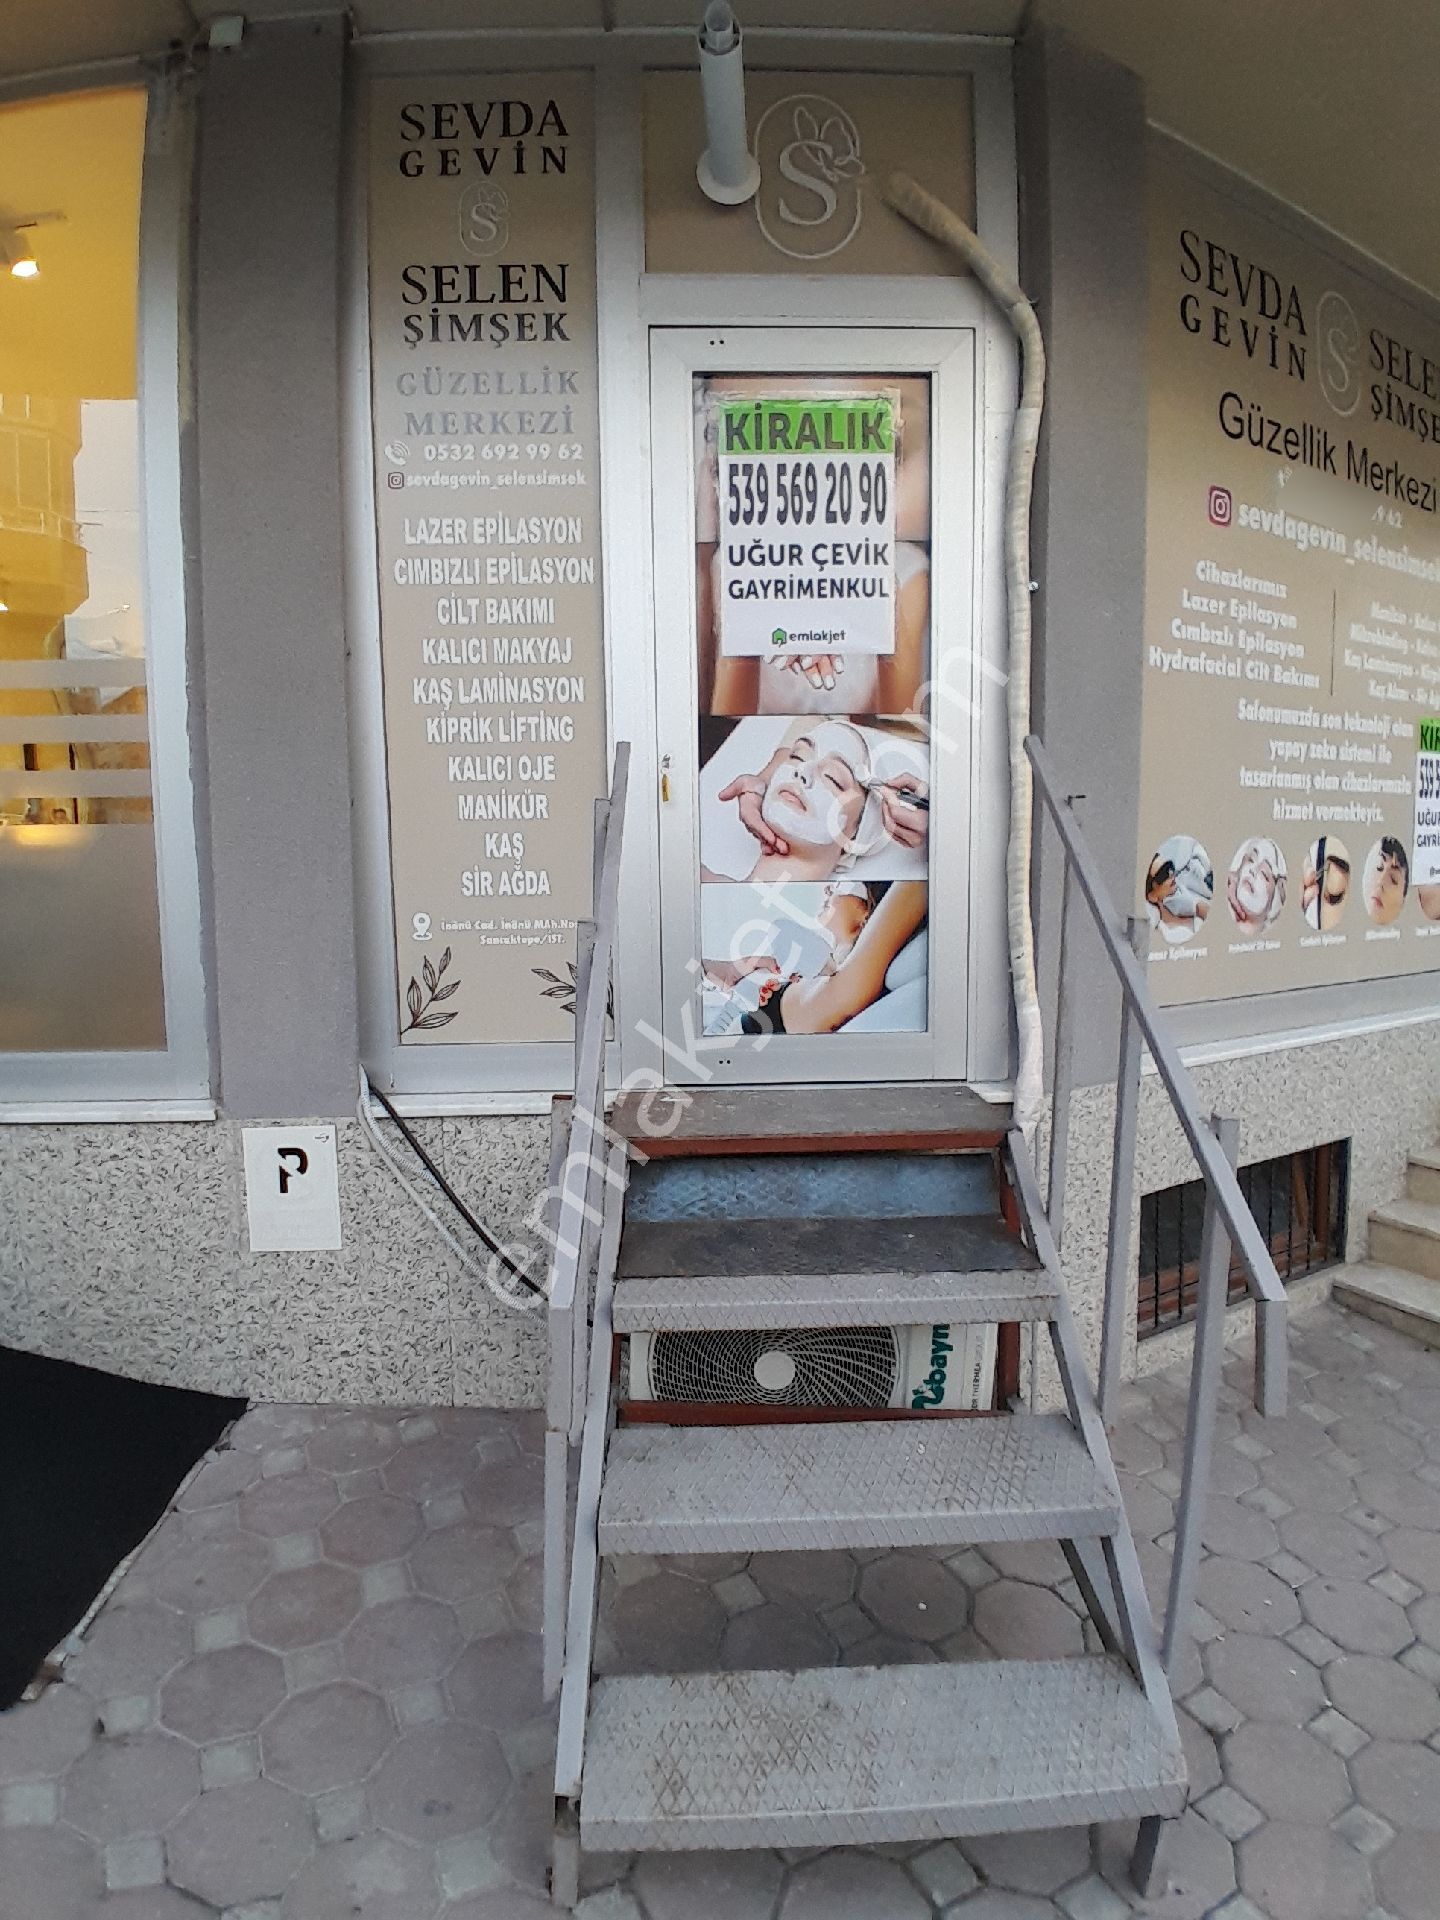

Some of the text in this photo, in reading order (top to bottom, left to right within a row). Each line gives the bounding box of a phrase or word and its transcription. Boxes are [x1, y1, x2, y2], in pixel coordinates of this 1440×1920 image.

[400, 100, 569, 142] SEVDA
[400, 140, 567, 178] GEVİN
[402, 264, 569, 305] SELEN
[1180, 230, 1308, 336] SEVDA
[404, 308, 570, 350] ŞİMŞEK
[1180, 294, 1307, 381] GEVİN
[1369, 328, 1440, 400] SELE
[397, 365, 579, 397] GÜZELLİK
[405, 405, 575, 436] MERKEZİ
[724, 402, 887, 451] KİRALIK
[425, 443, 584, 461] 0532 692 99 62
[1218, 391, 1437, 514] Güzellik Merkezi
[407, 470, 587, 490] sevdagevin_selensimsek
[728, 461, 887, 525] 539 569 20 90
[404, 512, 583, 545] LAZER EPİLASYON
[394, 552, 595, 585] CIMBIZLI EPİLASYON
[728, 537, 890, 572] UĞUR ÇEVİK
[728, 574, 890, 600] GAYRİMENKUL
[1182, 588, 1227, 616] Lazer
[437, 593, 555, 625] CİLT BAKIMI
[422, 637, 572, 665] KALICI MAKYAJ
[789, 630, 847, 644] emlakjet
[413, 671, 585, 711] KAŞ LAMİNASYON
[426, 710, 574, 743] KİPRİK LİFTİNG
[449, 755, 556, 782] KALICI OJE
[458, 788, 549, 820] MANİKÜR
[485, 832, 525, 865] KAŞ
[461, 864, 551, 897] SİR AĞDA
